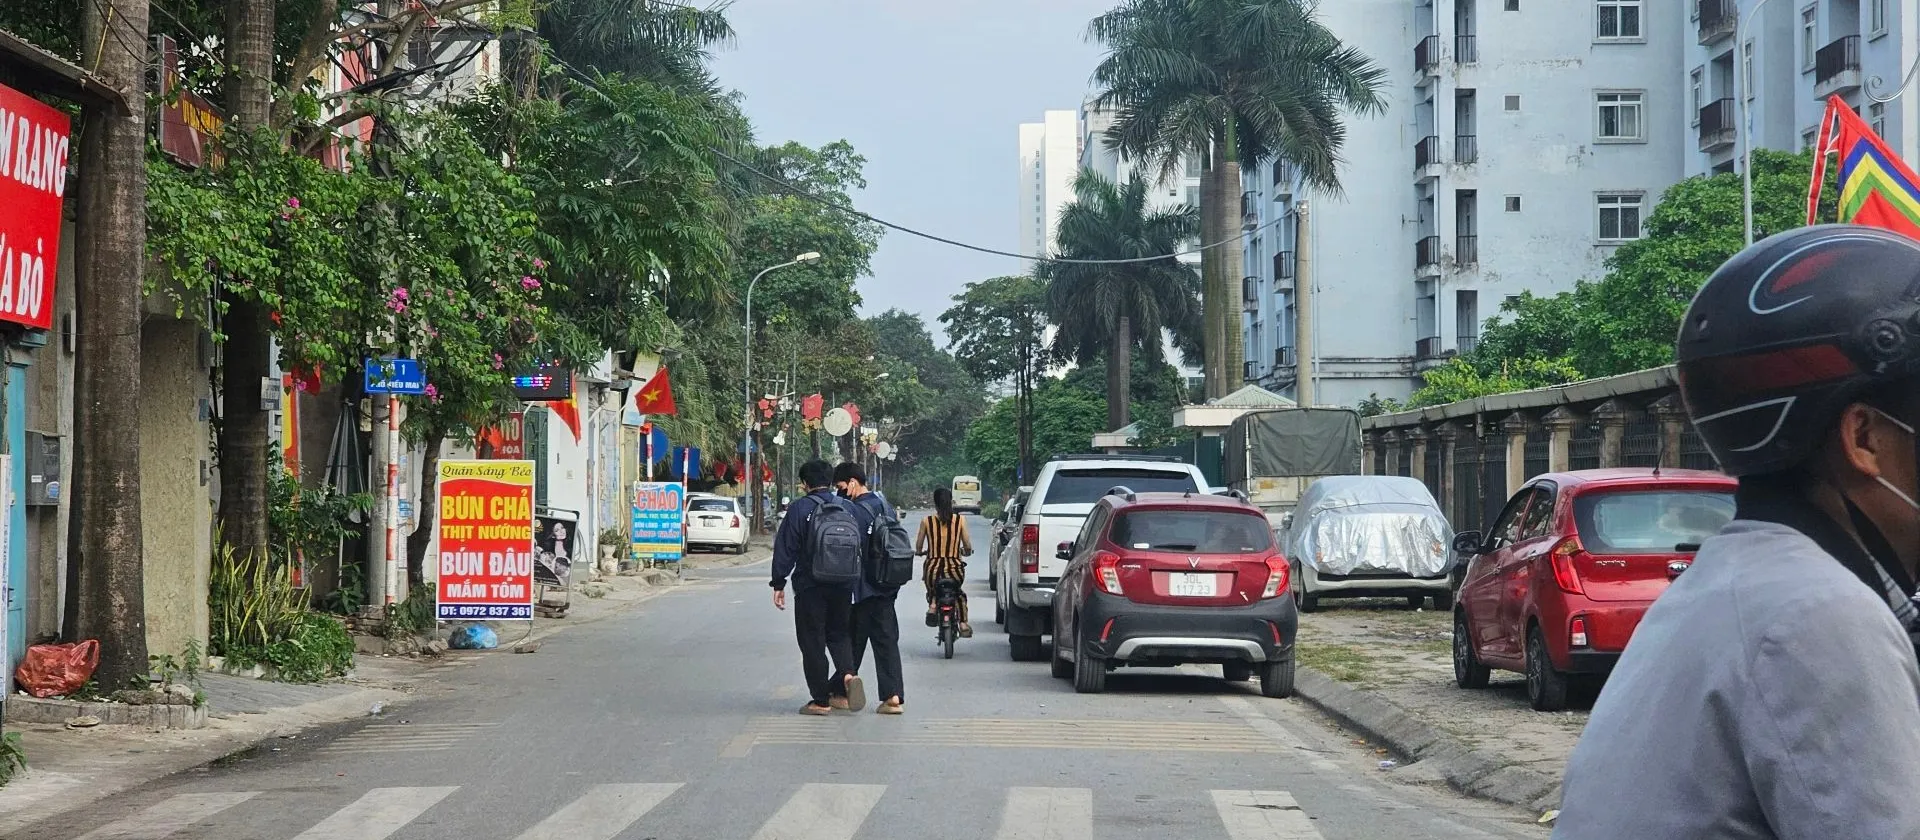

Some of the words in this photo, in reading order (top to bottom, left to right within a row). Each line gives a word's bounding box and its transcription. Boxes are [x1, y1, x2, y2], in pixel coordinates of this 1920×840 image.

[14, 116, 69, 198] RANG
[16, 237, 44, 319] BÒ
[442, 465, 473, 478] Quán
[476, 465, 505, 479] Sáng
[442, 490, 484, 520] BÚN
[490, 488, 531, 520] CHẢ
[441, 525, 474, 543] THỊT
[478, 523, 531, 540] NƯỚNG
[441, 546, 484, 576] BÚN
[489, 547, 531, 582] ĐẬU
[447, 578, 487, 598] MẮM
[490, 581, 524, 598] TÔM
[1183, 574, 1202, 584] 30L
[1176, 584, 1211, 595] 117.23
[440, 606, 457, 616] ĐT:
[459, 606, 486, 616] 0972
[489, 606, 509, 616] 837
[511, 606, 530, 616] 361
